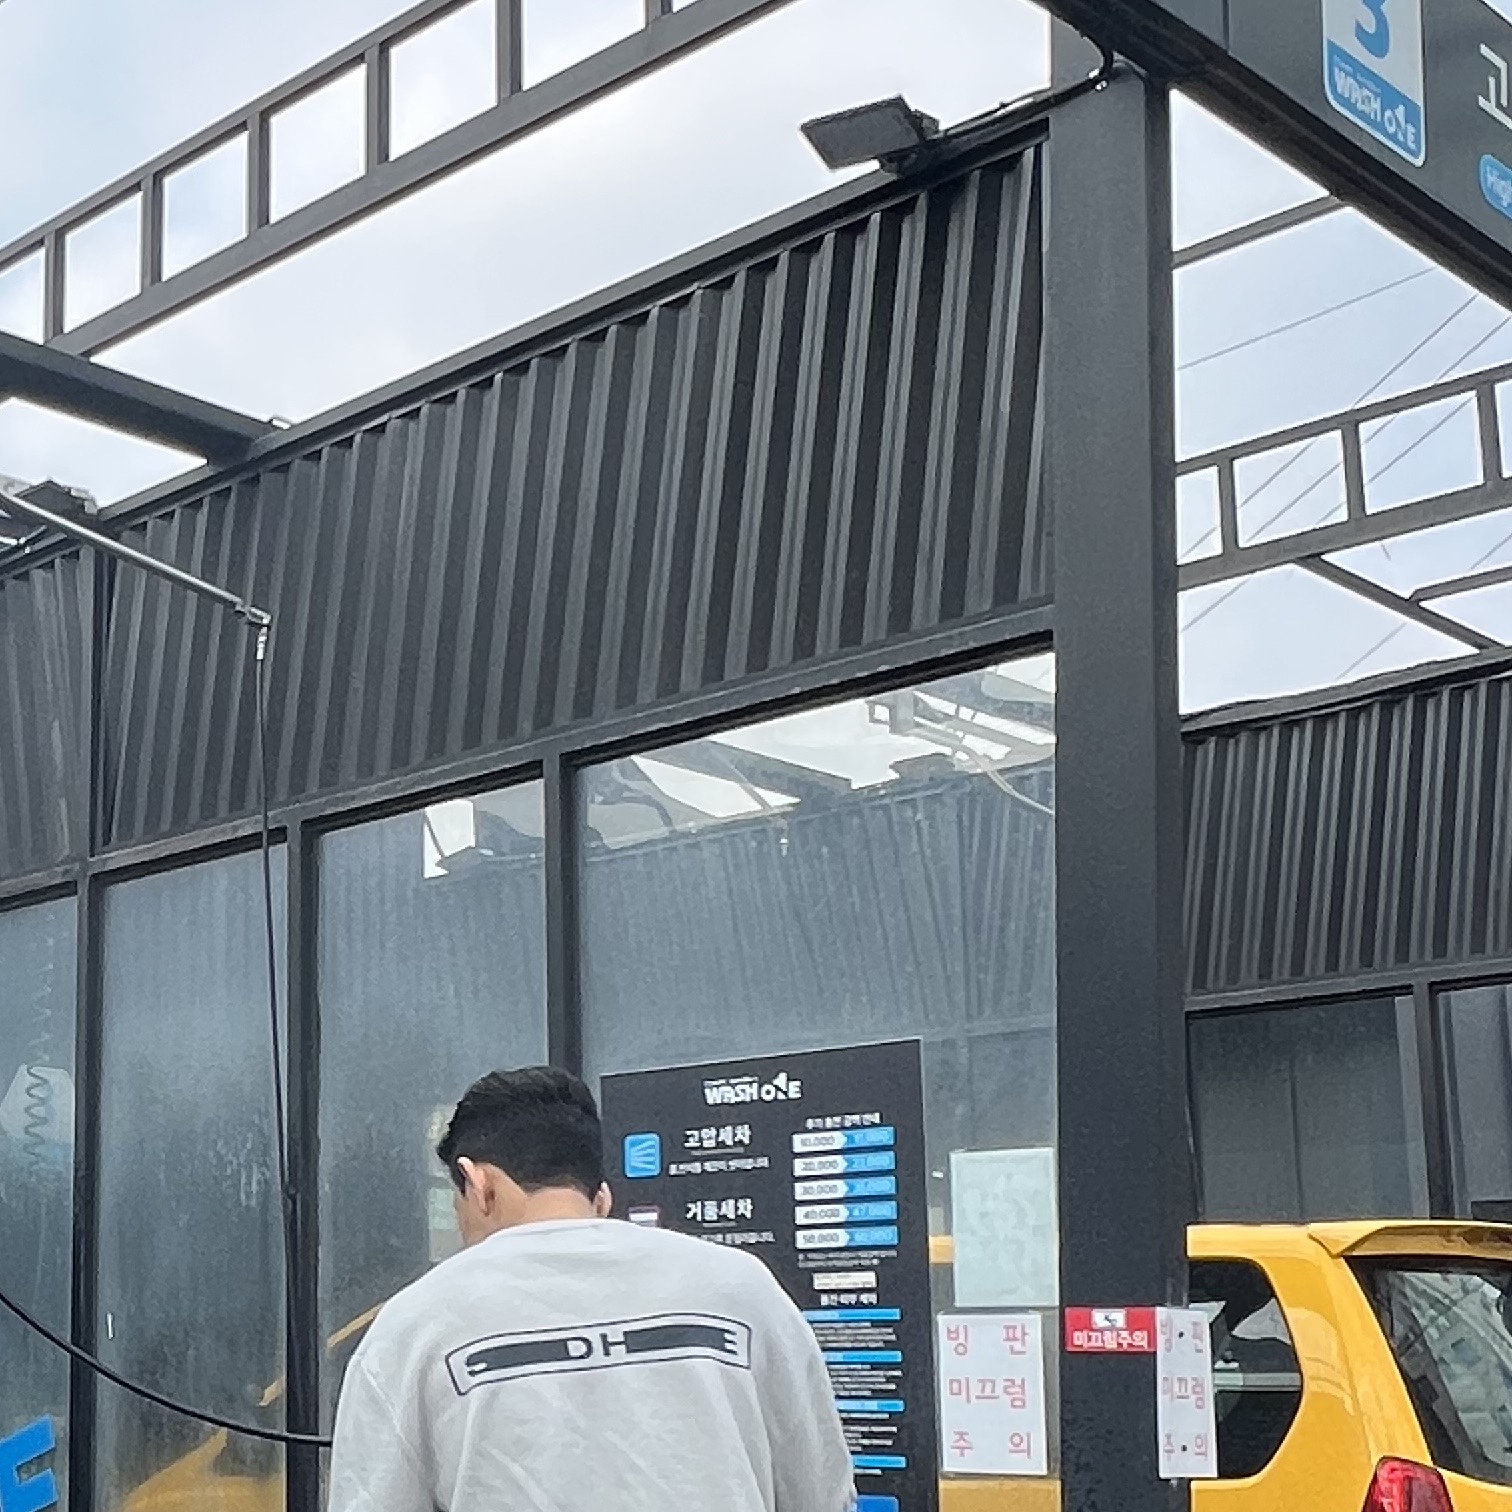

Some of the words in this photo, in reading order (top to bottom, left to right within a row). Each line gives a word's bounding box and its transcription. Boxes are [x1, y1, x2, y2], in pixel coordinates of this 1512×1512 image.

[704, 1082, 759, 1104] WASH
[684, 1124, 751, 1148] 고압세차
[948, 1377, 1027, 1410] 미끄럼
